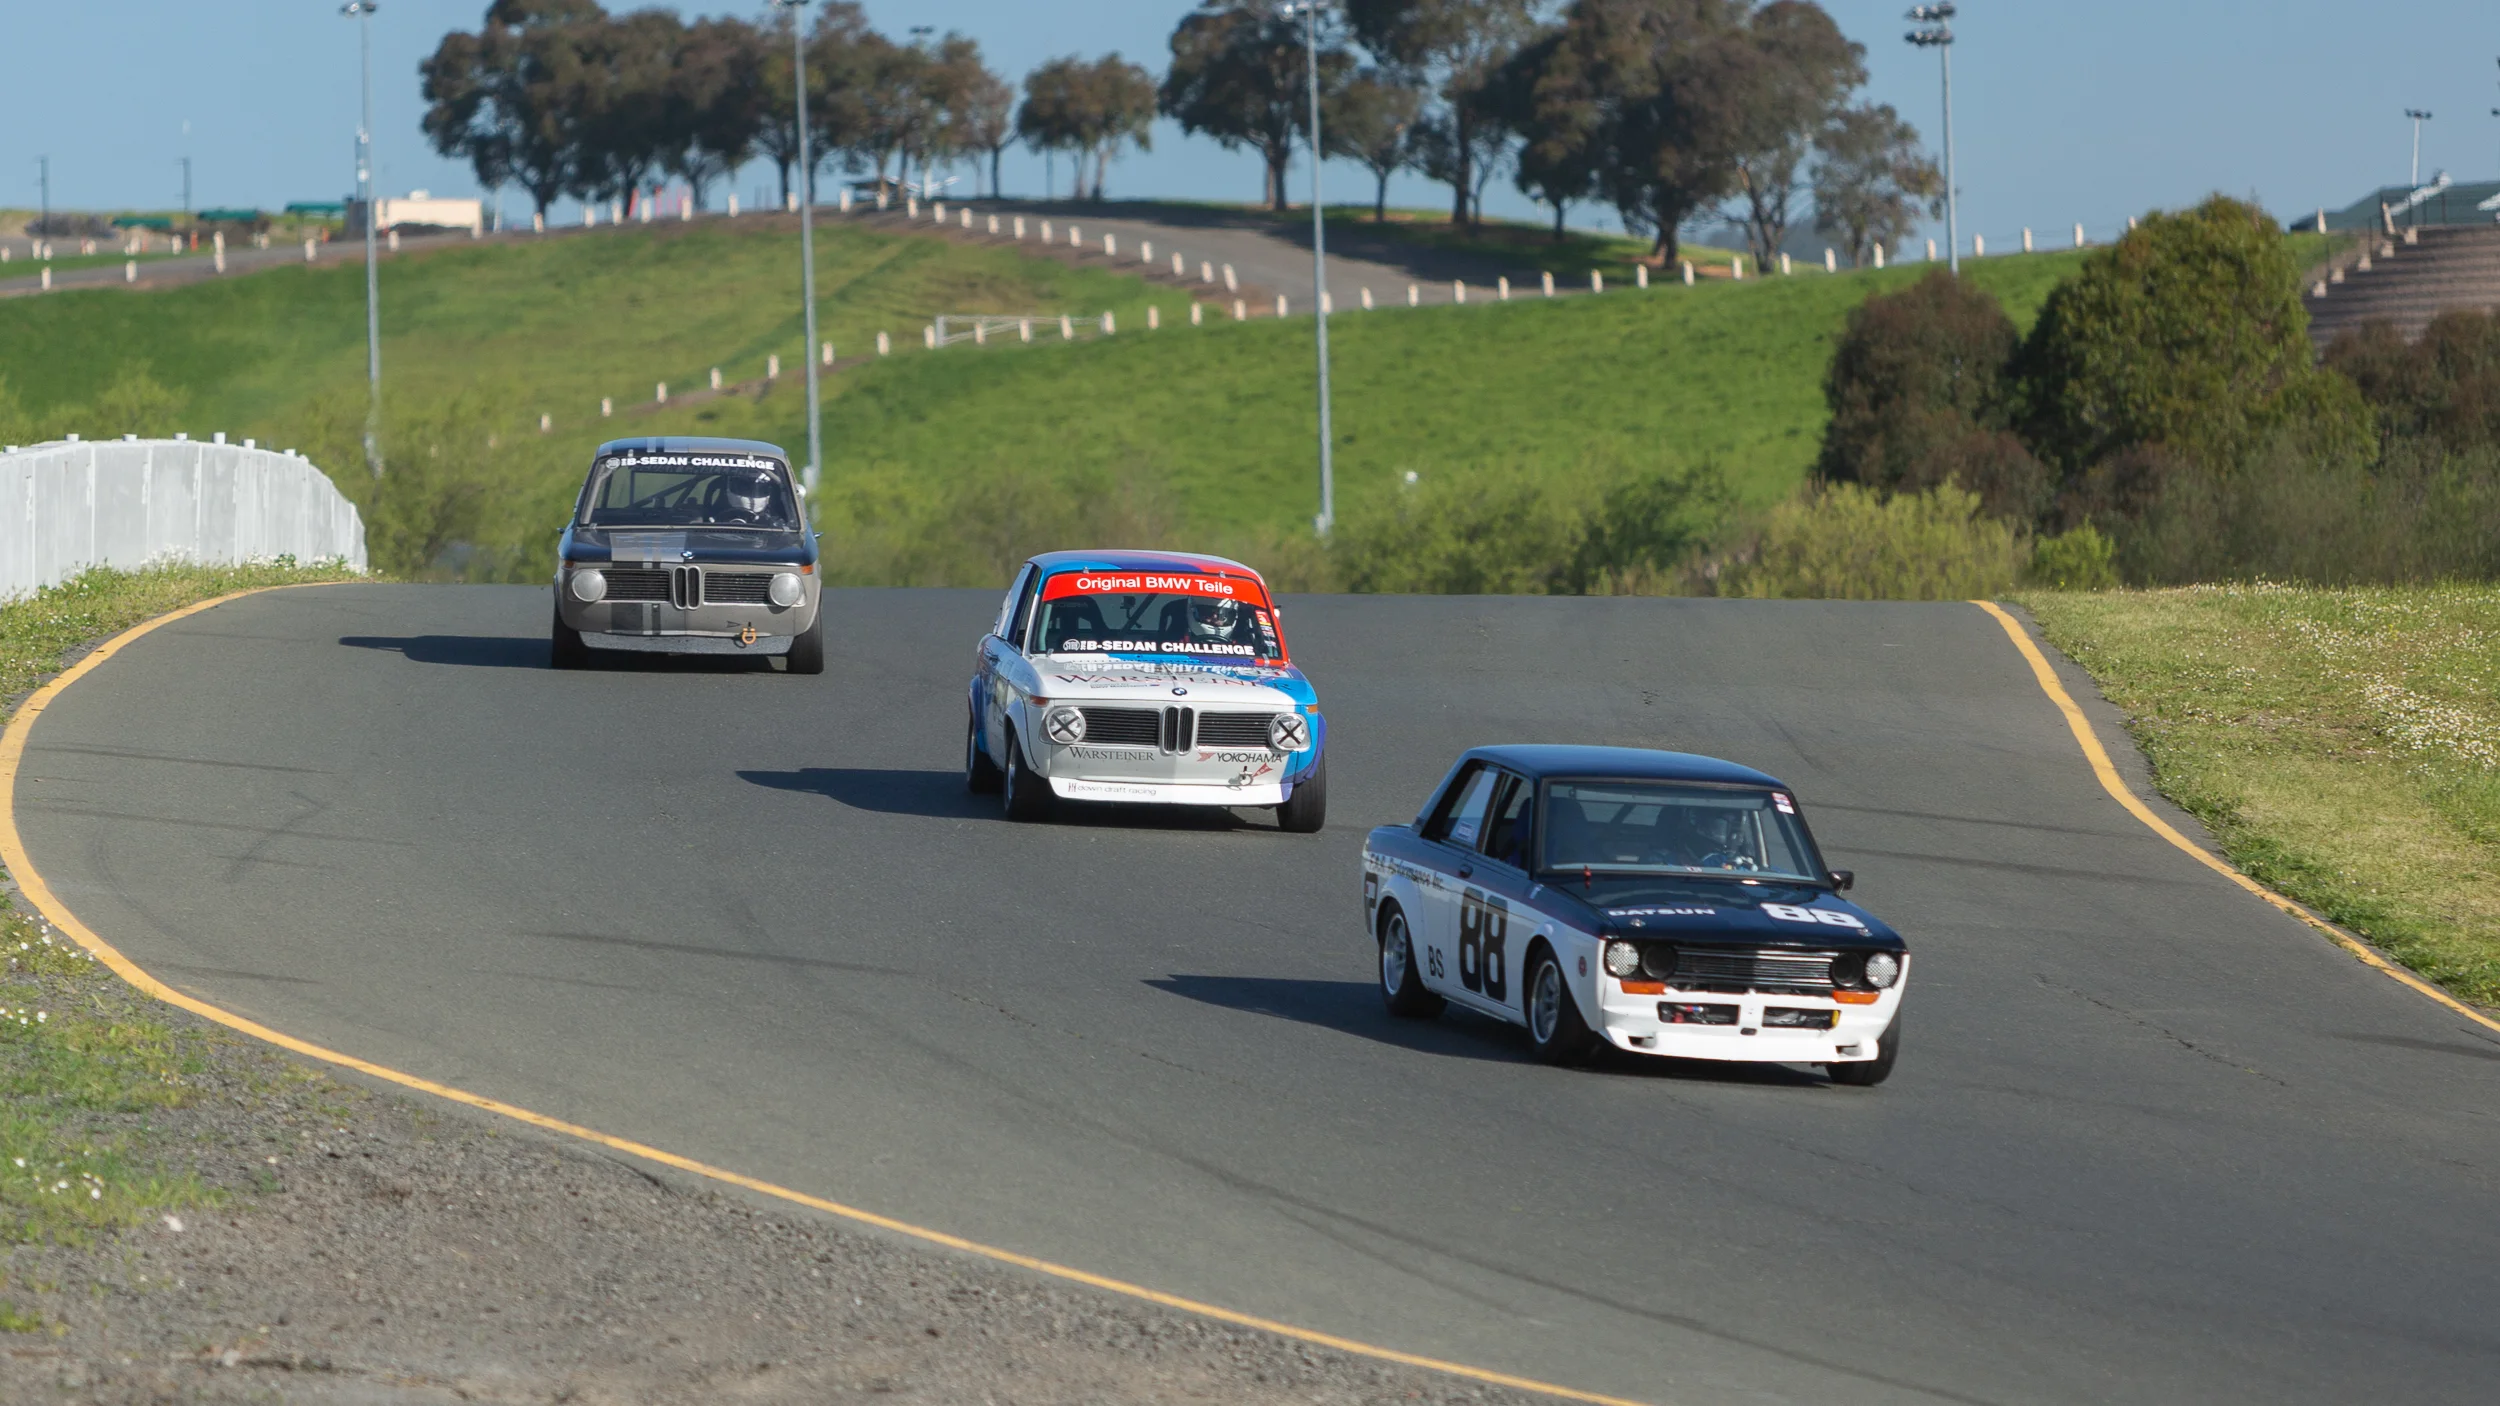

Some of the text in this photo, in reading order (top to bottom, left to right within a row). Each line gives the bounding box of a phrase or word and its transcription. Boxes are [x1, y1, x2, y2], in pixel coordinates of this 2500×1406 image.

[691, 457, 775, 470] CHALLENGE
[1076, 577, 1234, 594] Original BMW Teile
[1161, 641, 1256, 656] CHALLENGE
[1069, 746, 1155, 761] WARSTEINER
[1217, 752, 1283, 763] YOKOHAMA
[1608, 908, 1716, 916] DATSUN
[1760, 902, 1865, 929] 88
[1459, 886, 1508, 1003] 88
[1428, 944, 1444, 979] BS
